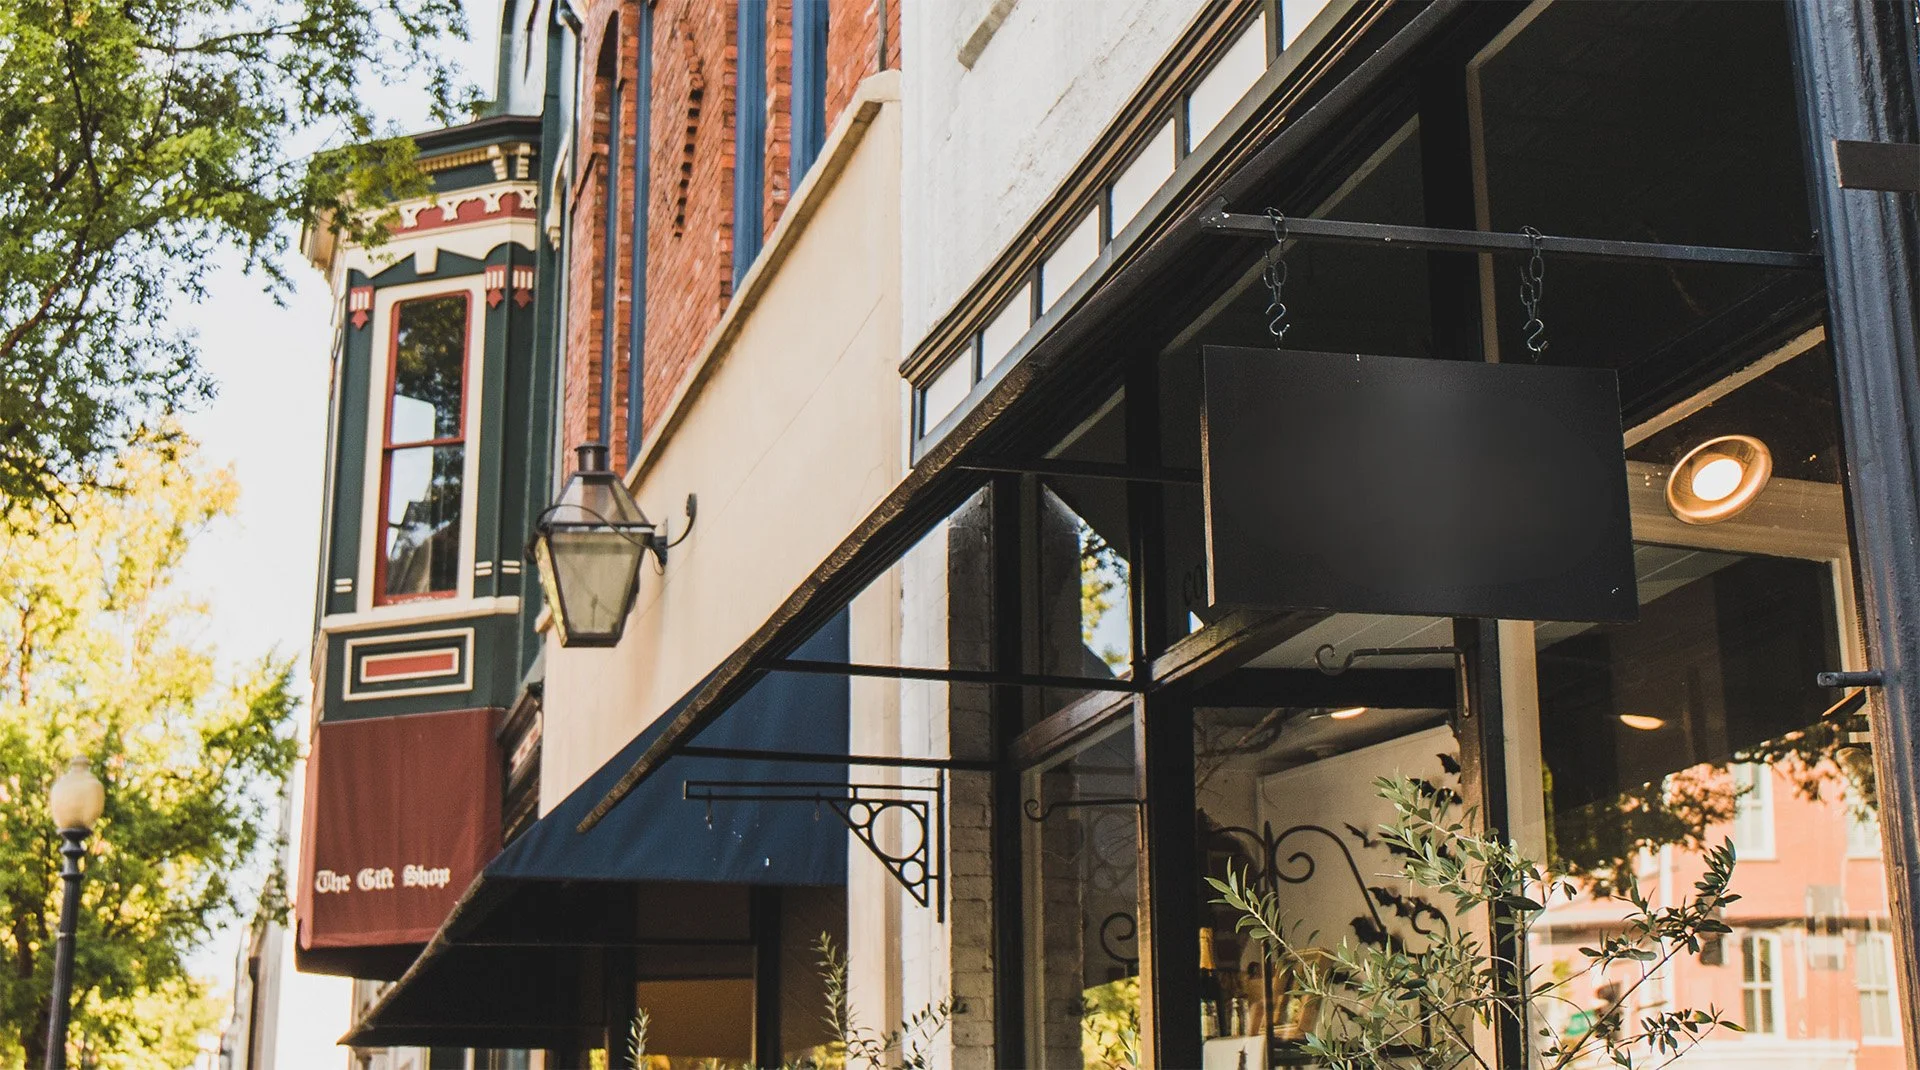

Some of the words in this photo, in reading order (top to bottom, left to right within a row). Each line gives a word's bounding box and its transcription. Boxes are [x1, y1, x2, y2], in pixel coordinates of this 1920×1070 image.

[315, 869, 351, 893] The
[356, 867, 394, 891] Gift
[402, 864, 451, 889] Shop
